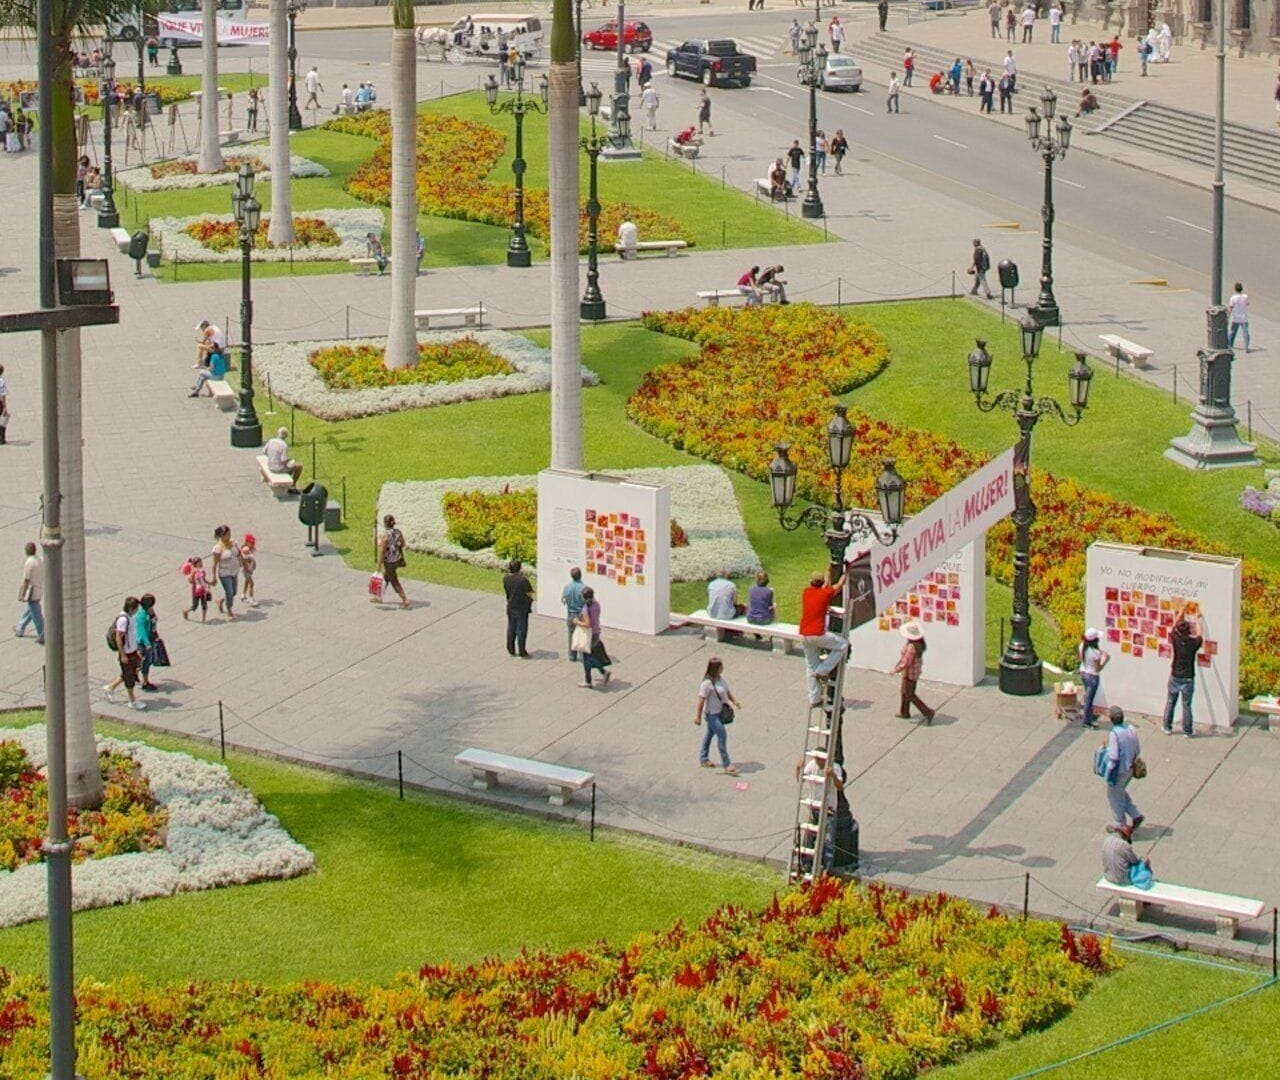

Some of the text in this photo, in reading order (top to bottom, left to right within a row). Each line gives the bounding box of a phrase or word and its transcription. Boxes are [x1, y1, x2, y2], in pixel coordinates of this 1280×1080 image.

[876, 469, 1009, 593] ¡QUE VIVA LA MUJER!
[1100, 566, 1112, 576] YO
[1118, 569, 1132, 578] NO
[1120, 581, 1199, 598] CUERPO PORQUE
